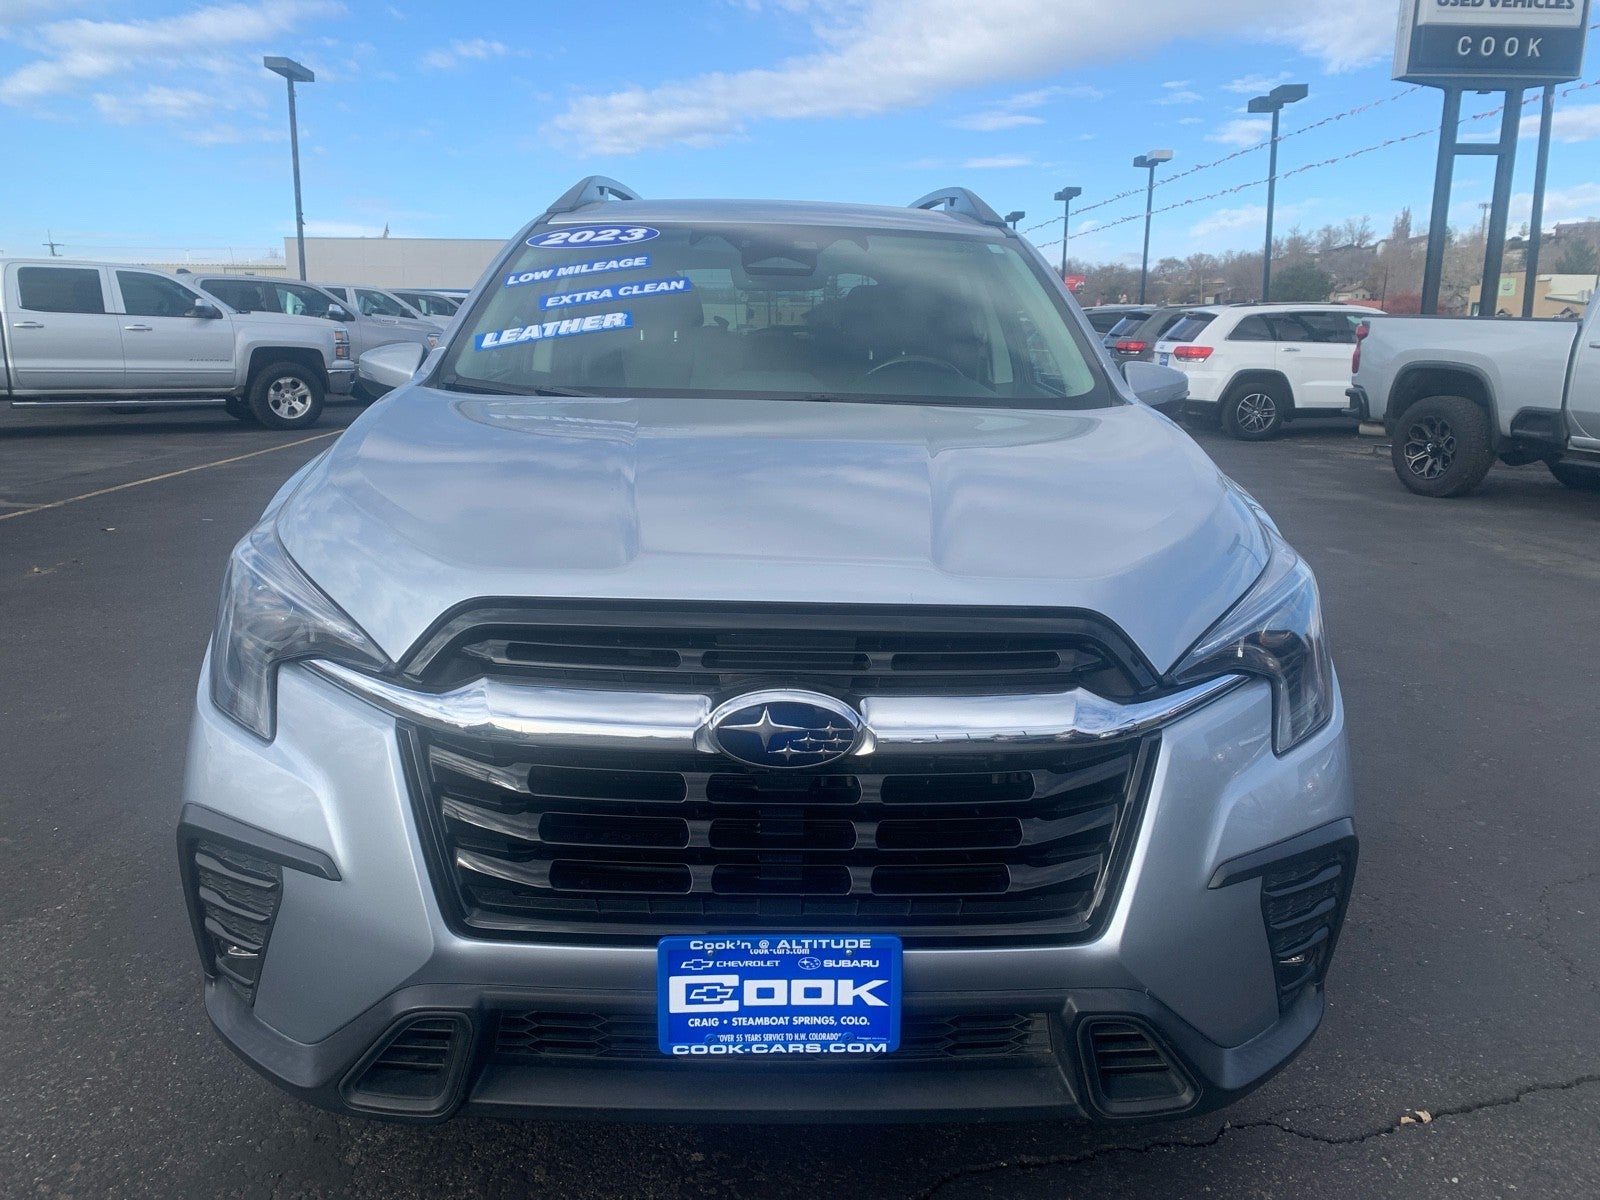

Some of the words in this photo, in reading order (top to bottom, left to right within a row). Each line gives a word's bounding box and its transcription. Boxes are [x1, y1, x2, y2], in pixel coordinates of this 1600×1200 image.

[1437, 0, 1483, 8] USED
[1489, 0, 1575, 10] VEHICLES
[1457, 35, 1543, 57] COOK
[538, 227, 648, 246] 2023
[506, 269, 554, 286] LOW
[556, 256, 648, 277] MILEAGE
[545, 289, 613, 307] EXTRA
[618, 279, 686, 297] CLEAN
[481, 312, 628, 348] LEATHER
[689, 939, 752, 951] Cook'n
[777, 938, 872, 950] ALTITUDE
[716, 959, 781, 968] CHEVROLET
[823, 959, 880, 968] SUBARU
[668, 974, 890, 1014] COOK
[688, 1017, 720, 1028] CRAIG
[731, 1016, 790, 1027] STEAMBOAT
[792, 1016, 838, 1027] SPRINGS,
[840, 1016, 871, 1026] COLO.
[736, 1034, 744, 1042] 55
[745, 1033, 762, 1042] YEARS
[762, 1033, 785, 1042] SERVICE
[785, 1033, 794, 1041] TO
[794, 1033, 808, 1041] N.W.
[672, 1043, 888, 1055] COOK-CARS.COM
